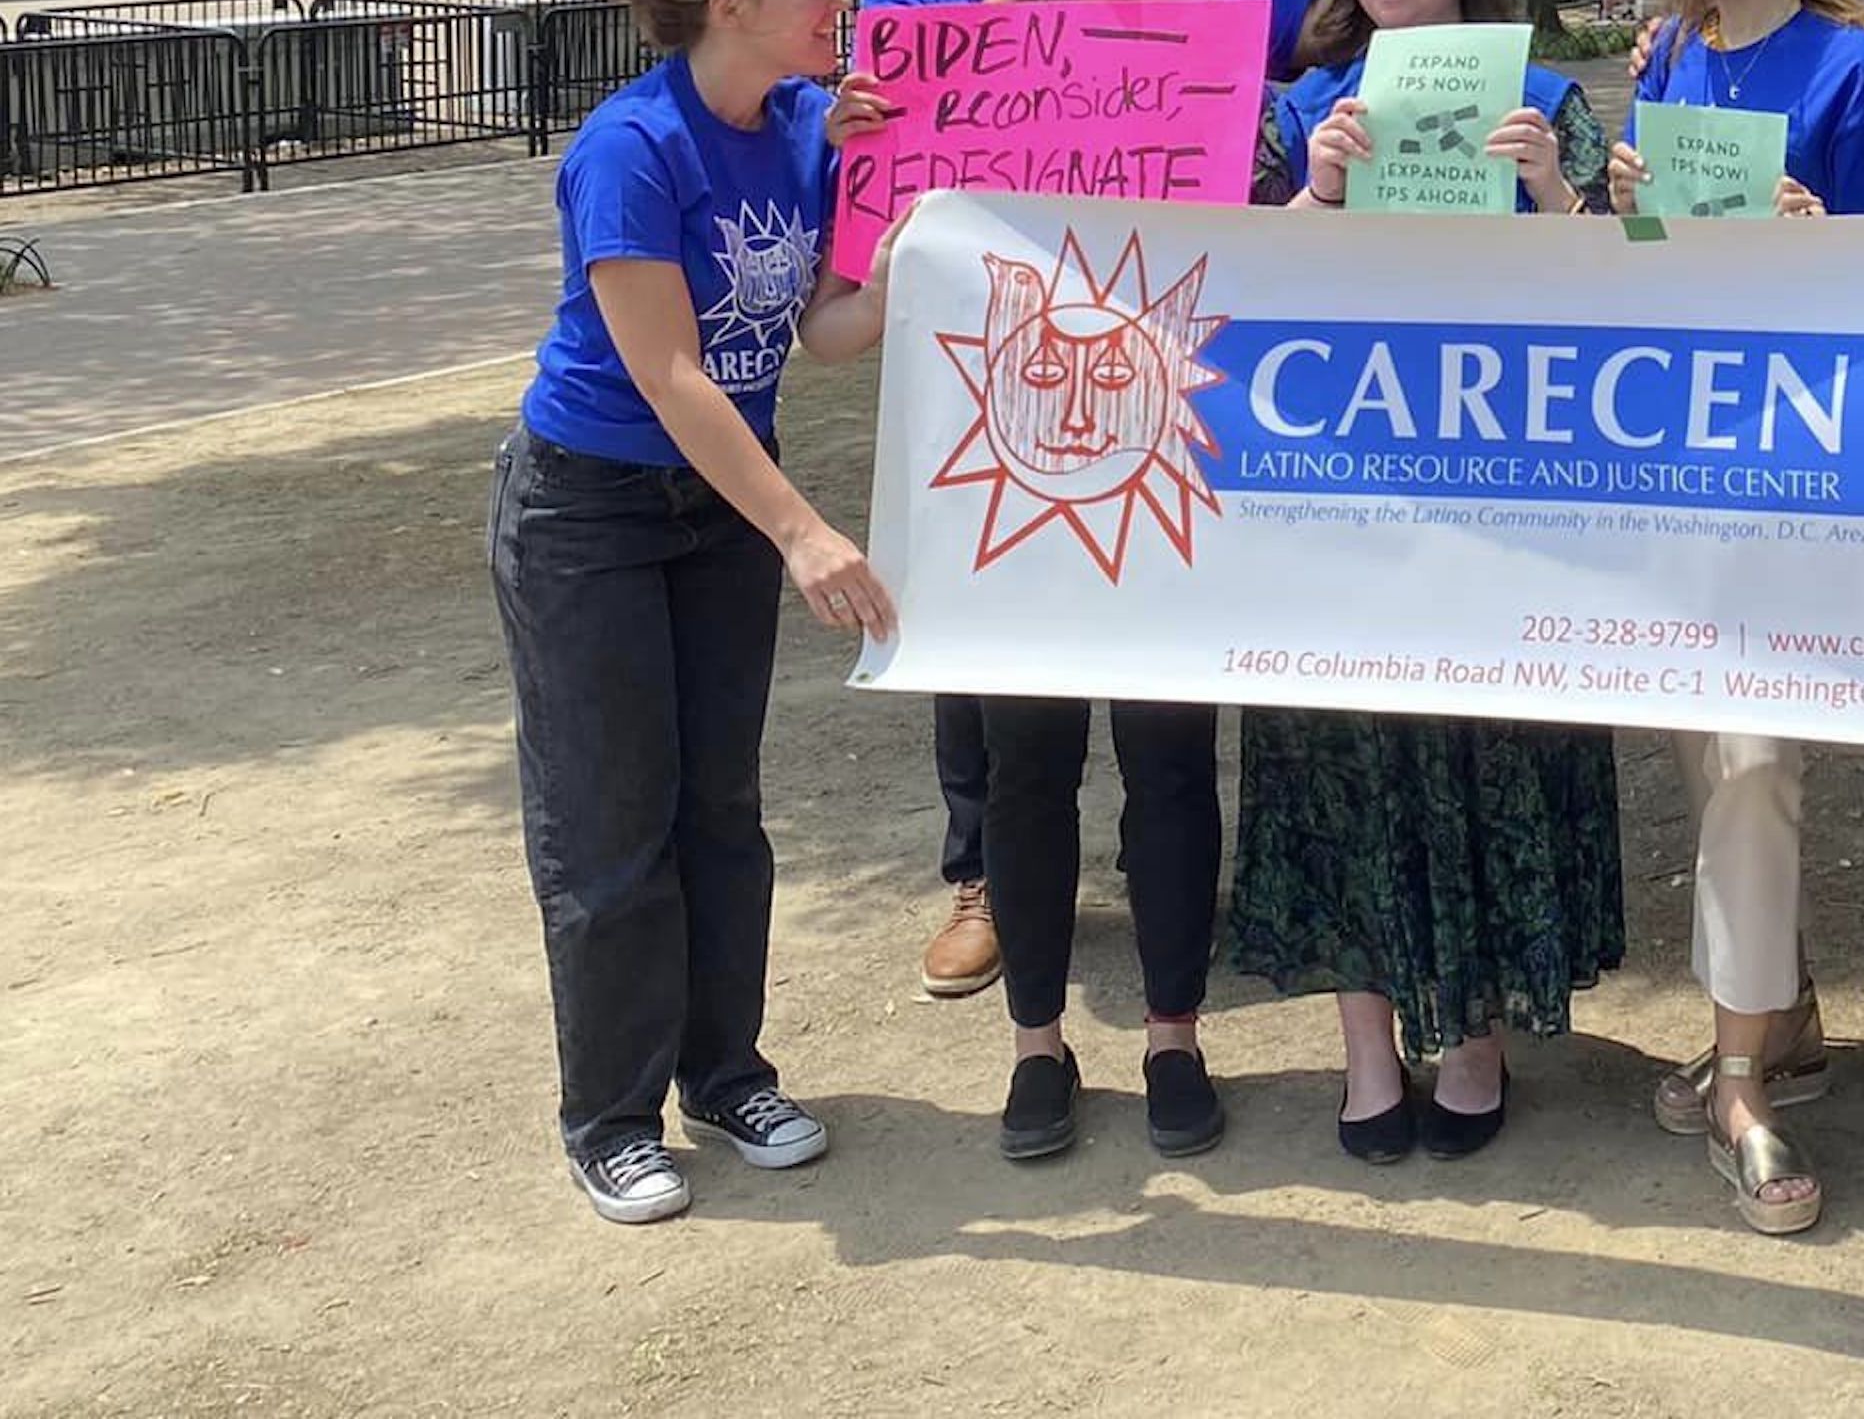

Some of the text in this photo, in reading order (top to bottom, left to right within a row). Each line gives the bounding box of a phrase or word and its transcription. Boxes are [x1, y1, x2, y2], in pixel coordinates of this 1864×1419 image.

[870, 11, 1072, 80] BIDEN,
[1409, 55, 1480, 70] EXPAND
[1396, 76, 1487, 92] TPS NOW!
[1677, 135, 1740, 157] EXPAND
[1671, 156, 1749, 182] TPS NOW!
[1376, 186, 1488, 205] TPS AHORA!
[1248, 338, 1850, 456] CARECEN
[1239, 450, 1843, 501] LATINO RESOURCE AND JUSTICE CENTER
[1239, 499, 1371, 526] Strengthening
[1375, 501, 1408, 523] the
[1413, 505, 1473, 525] Latino
[1477, 505, 1592, 531] Community
[1596, 510, 1614, 528] in
[1619, 509, 1650, 533] the
[1520, 615, 1720, 650] 202-328-9799
[1222, 647, 1289, 677] 1460
[1297, 651, 1426, 683] Columbia
[1434, 657, 1505, 686] Road
[1513, 661, 1570, 693] NW,
[1578, 664, 1652, 694] Suite
[1658, 668, 1705, 696] C-1
